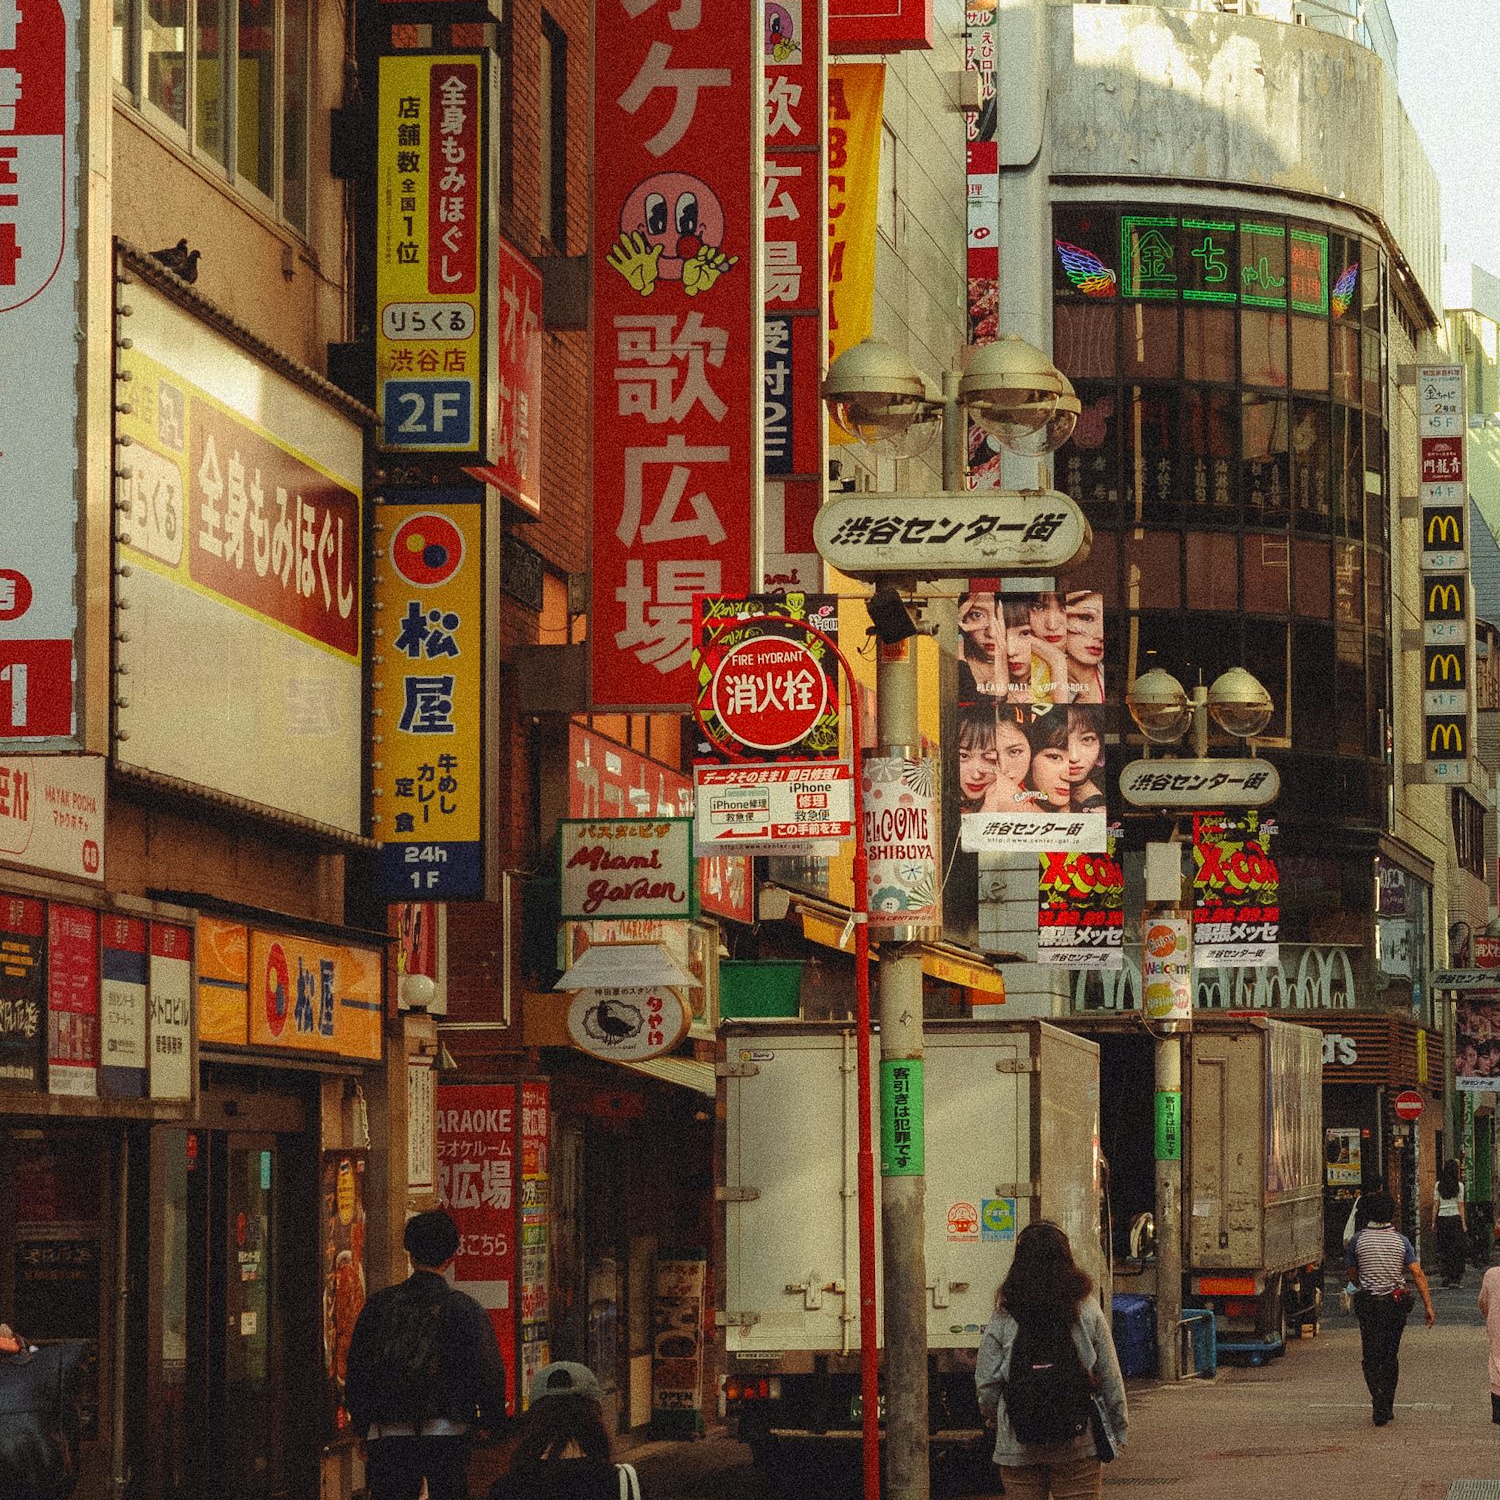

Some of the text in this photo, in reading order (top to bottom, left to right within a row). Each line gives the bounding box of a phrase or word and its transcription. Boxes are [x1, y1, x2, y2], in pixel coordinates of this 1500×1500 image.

[981, 32, 996, 99] えびロール
[440, 75, 468, 283] 全身もみほぐし
[1131, 229, 1285, 290] 金ちゃん
[390, 310, 466, 332] りらくる
[389, 348, 467, 373] 渋谷店
[397, 392, 461, 433] 2F
[613, 312, 731, 676] 歌広場
[198, 434, 355, 621] 全身もみほぐし
[829, 511, 1069, 547] 渋谷センター街
[394, 601, 460, 735] 松屋
[732, 650, 804, 667] FIRE HYDRANT
[725, 668, 816, 716] 消火栓
[417, 763, 435, 823] カレー
[437, 754, 458, 814] 牛めし
[789, 782, 832, 794] iPhone
[1129, 771, 1269, 792] 渋谷センター街
[394, 777, 416, 833] 定食
[797, 793, 827, 808] 修理
[794, 808, 831, 822] 救急便
[866, 808, 929, 843] ELCOME
[776, 822, 842, 836] この手前を左
[983, 821, 1084, 837] 渋谷センター街
[404, 846, 448, 864] 24h
[566, 845, 663, 871] Miami
[869, 844, 935, 861] SHIBUYA
[410, 871, 439, 888] 1F
[1038, 926, 1124, 947] 幕張メッセ
[1146, 932, 1176, 950] Enjoy
[1195, 922, 1278, 944] 幕張メッセ
[1050, 952, 1111, 963] 渋谷センター街
[1206, 949, 1264, 959] 渋谷センター街
[294, 956, 334, 1037] 松屋
[437, 1109, 512, 1133] ARAOKE
[892, 1066, 911, 1169] 客引きは犯罪です
[436, 1140, 512, 1157] ラオケルーム
